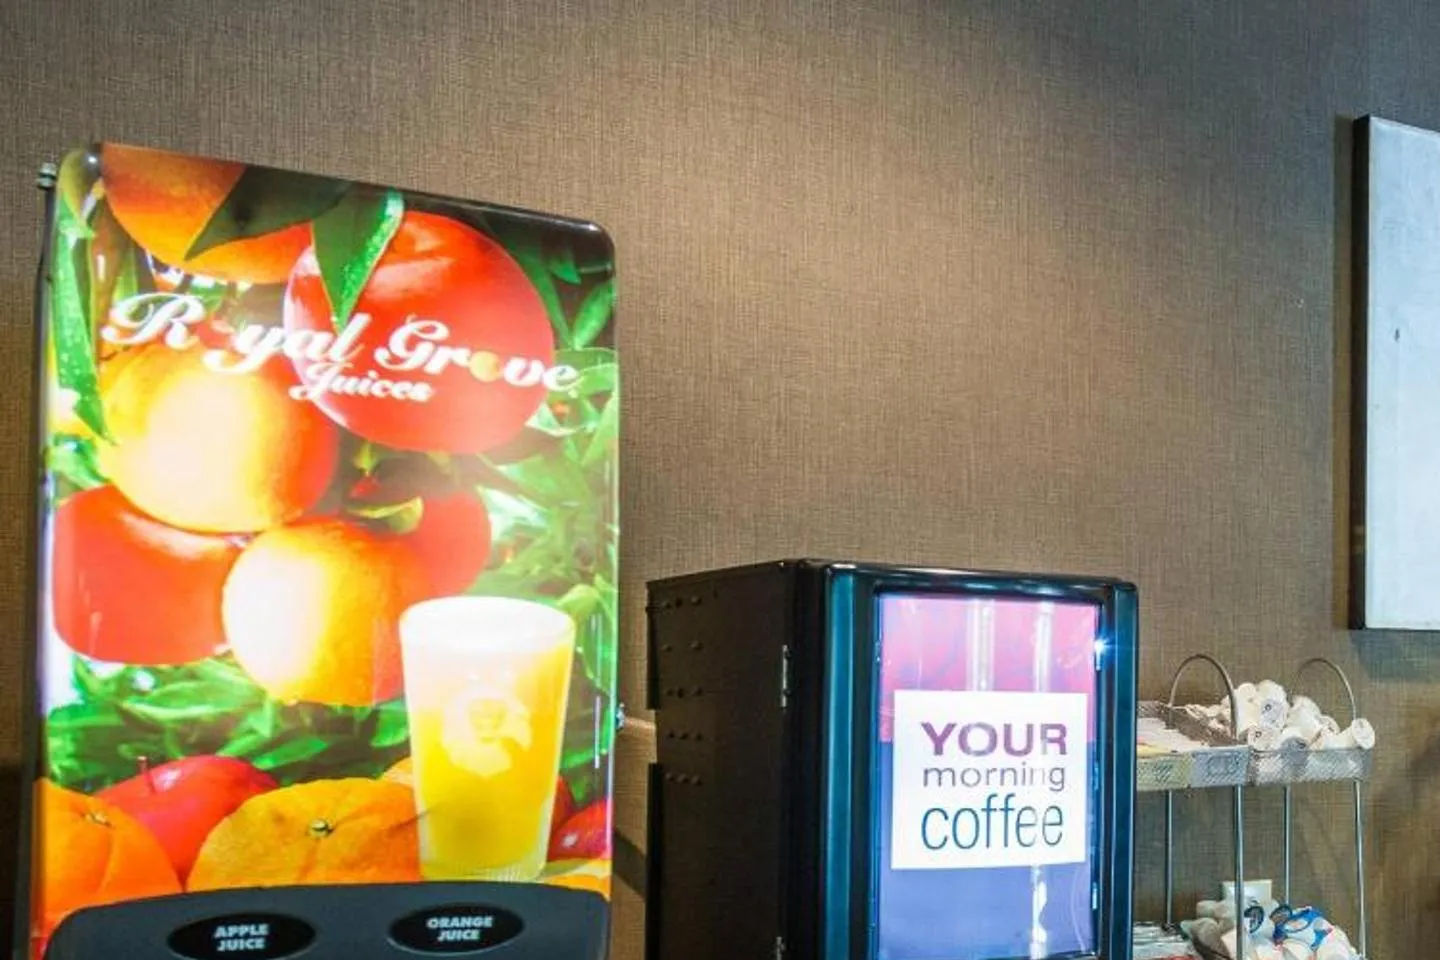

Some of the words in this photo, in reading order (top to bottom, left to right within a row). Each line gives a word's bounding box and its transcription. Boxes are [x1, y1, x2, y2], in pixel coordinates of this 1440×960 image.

[373, 314, 583, 392] Grove
[289, 361, 433, 402] Juices
[920, 721, 1067, 757] YOUR
[922, 760, 1066, 792] morning
[920, 792, 1063, 851] coffee
[214, 922, 269, 939] APPLE
[426, 915, 493, 930] ORANGE
[436, 928, 480, 942] JUICE
[217, 937, 266, 951] JUICE
